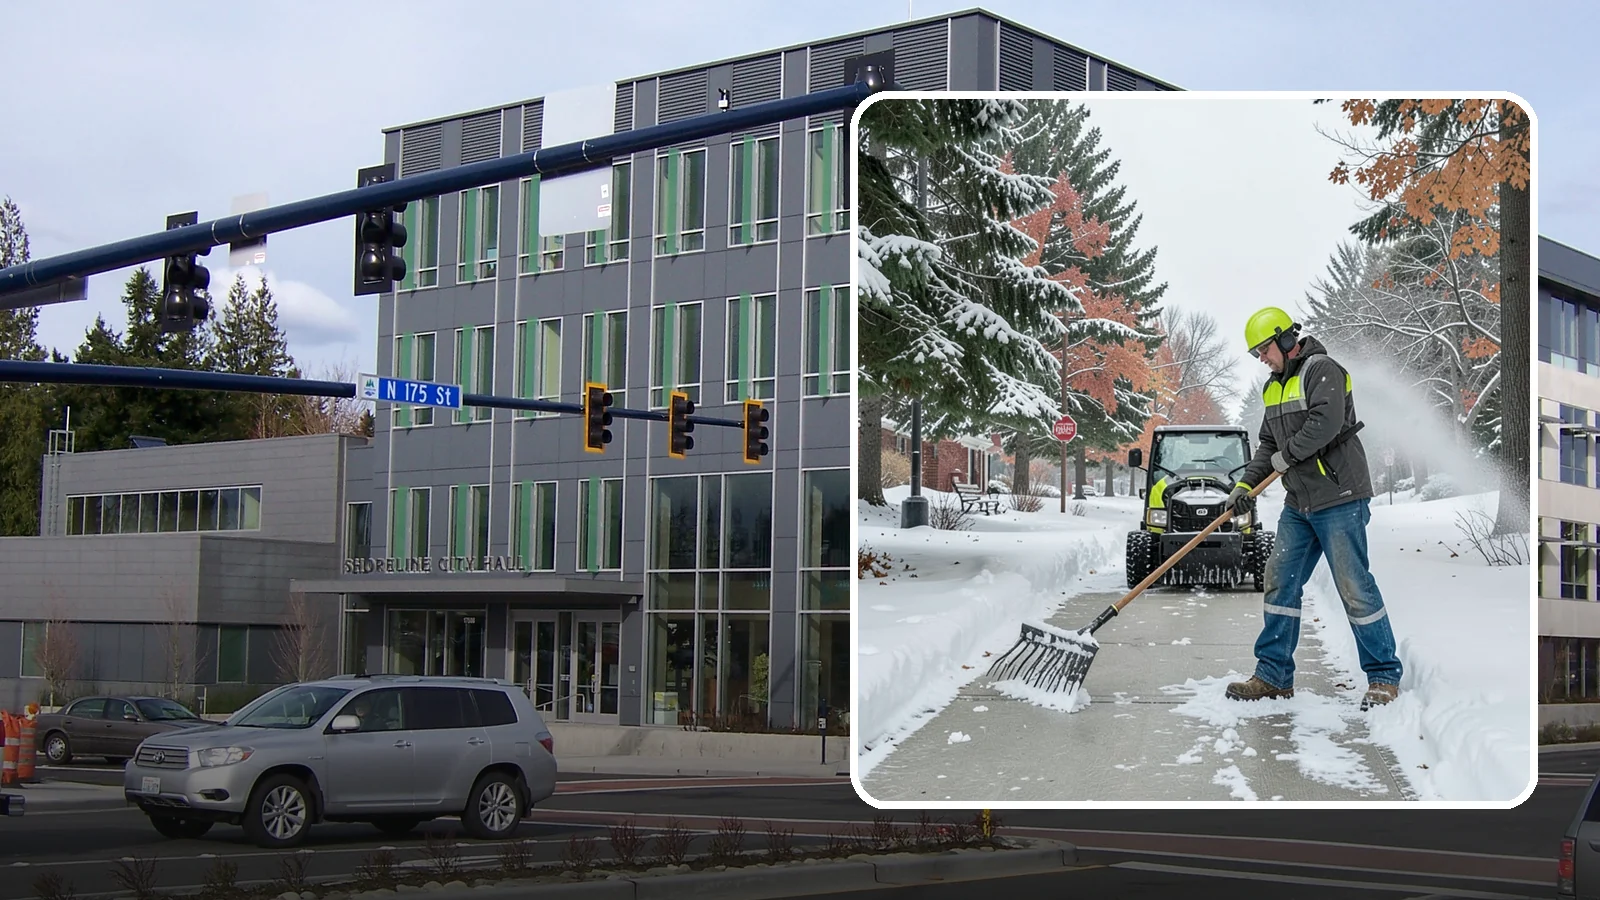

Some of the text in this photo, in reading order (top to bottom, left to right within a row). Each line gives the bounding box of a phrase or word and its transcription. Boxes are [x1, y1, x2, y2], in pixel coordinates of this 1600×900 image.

[387, 380, 451, 406] N 175 St
[343, 555, 526, 574] SHORELINE CITY HALL
